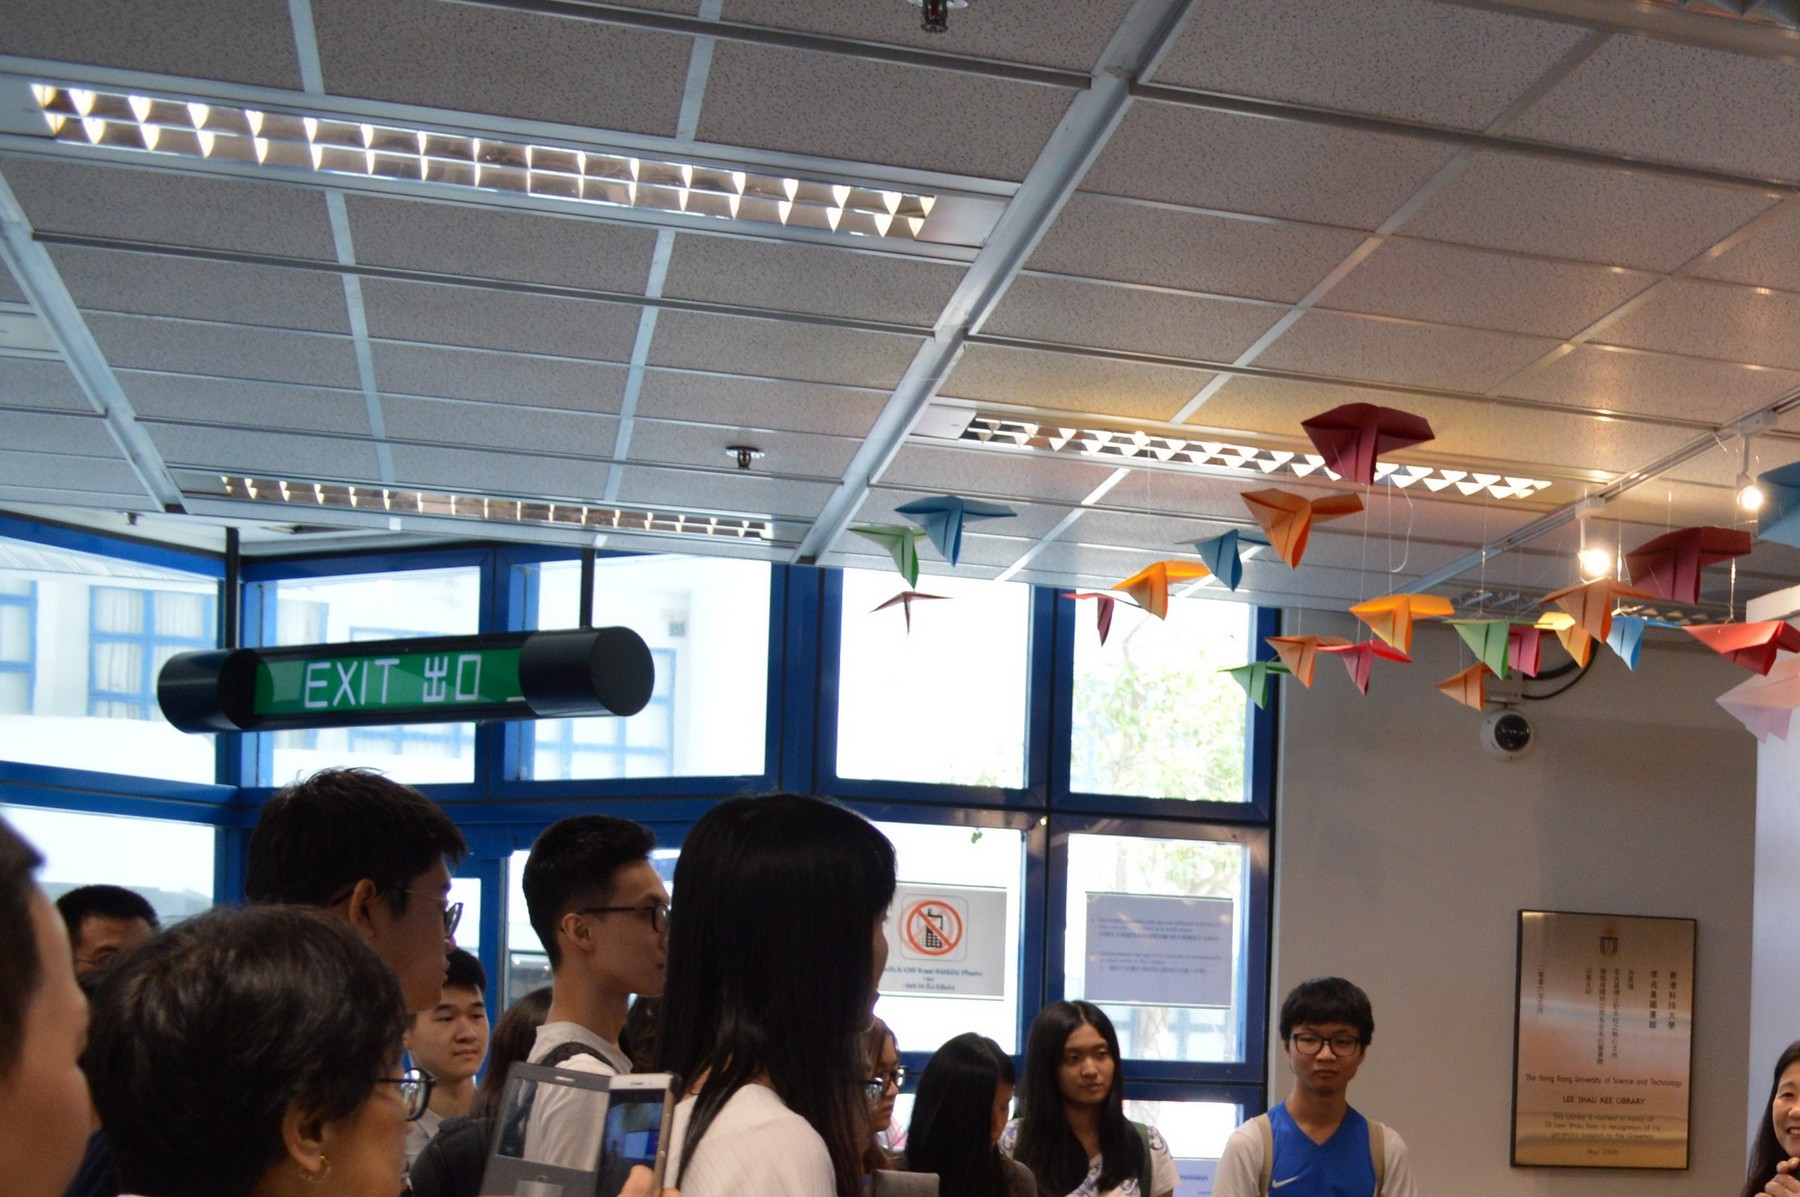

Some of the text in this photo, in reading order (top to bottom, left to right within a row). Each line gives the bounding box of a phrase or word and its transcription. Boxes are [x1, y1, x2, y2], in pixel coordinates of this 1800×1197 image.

[304, 658, 400, 708] EXIT
[422, 654, 482, 703] 出口
[1525, 1073, 1536, 1081] The
[1539, 1075, 1554, 1083] Hong
[1557, 1075, 1572, 1084] Kong
[1575, 1076, 1601, 1084] University
[1650, 1078, 1682, 1088] Technology
[1578, 1096, 1597, 1104] SHAU
[1600, 1096, 1613, 1104] KEE
[1616, 1097, 1645, 1105] LIBRARY
